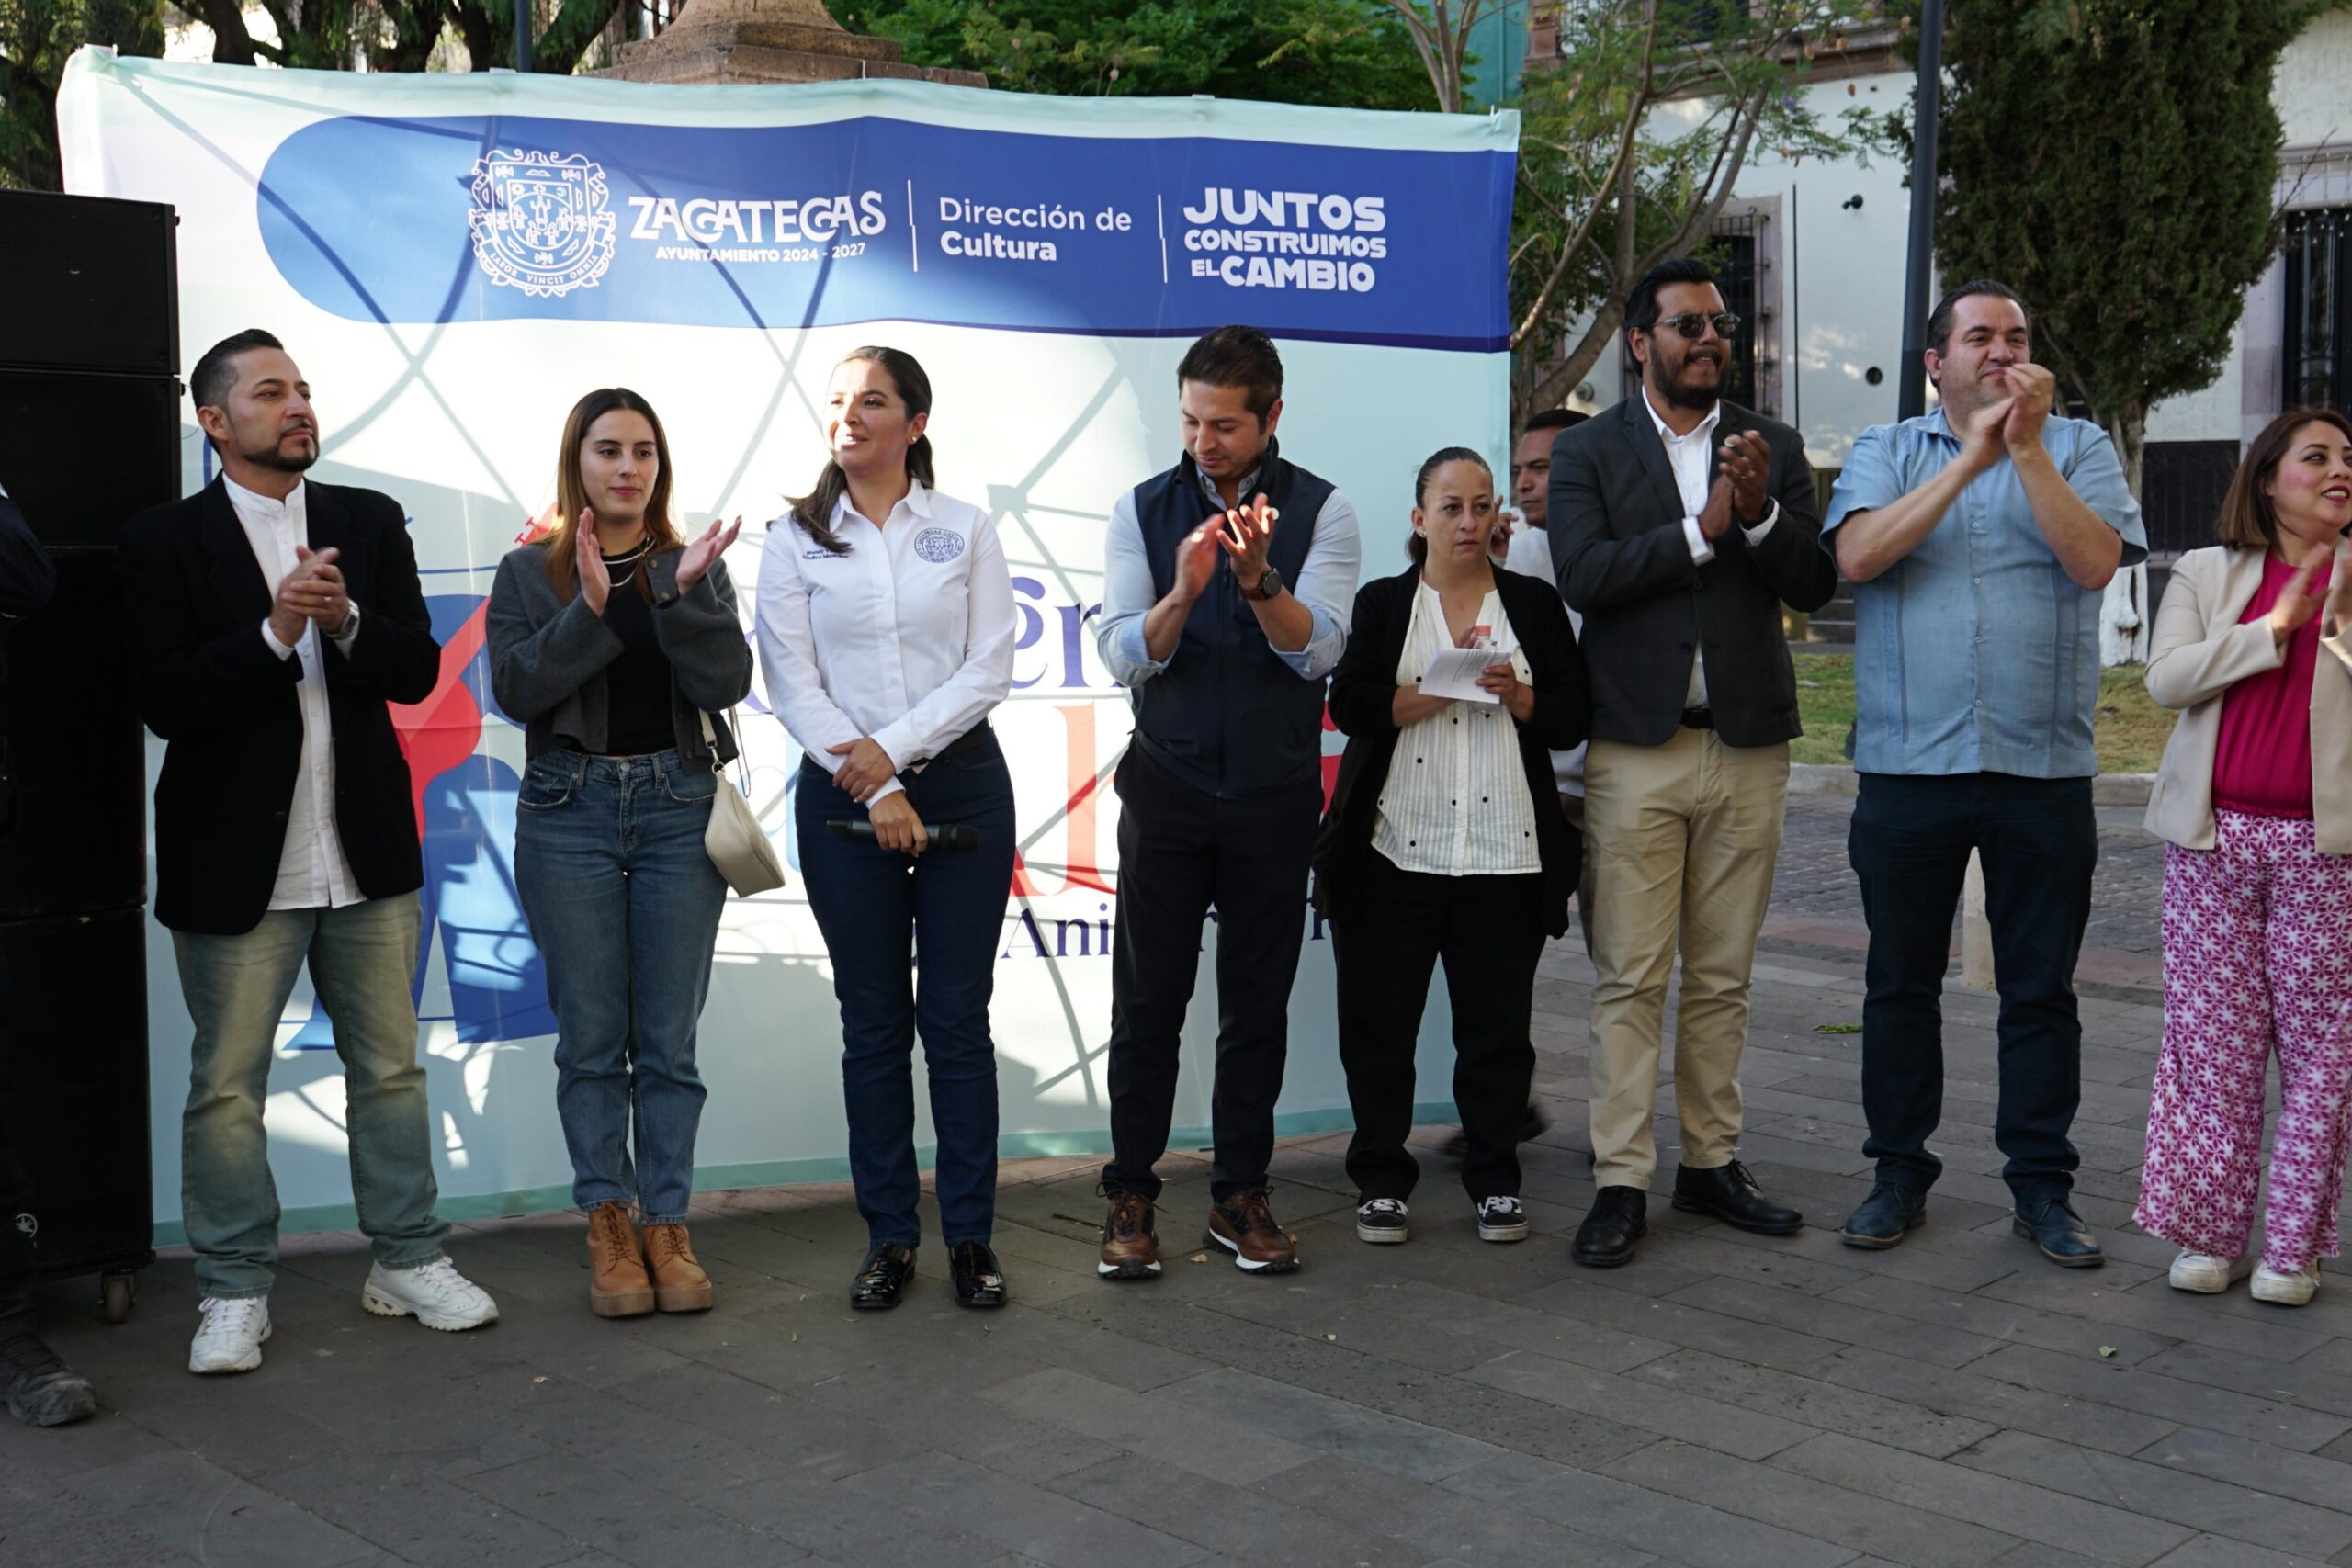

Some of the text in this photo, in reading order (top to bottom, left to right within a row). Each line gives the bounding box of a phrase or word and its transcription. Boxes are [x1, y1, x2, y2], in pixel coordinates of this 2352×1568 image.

[628, 190, 887, 243] ZACATECAS
[940, 197, 1132, 231] Dirección de
[1182, 187, 1386, 232] JUNTOS
[655, 246, 781, 263] AYUNTAMIENTO
[782, 247, 819, 263] 2024
[831, 242, 866, 259] 2027
[940, 231, 1057, 262] Cultura
[1183, 228, 1387, 259] CONSTRUIMOS
[490, 252, 599, 285] LABOR VINCIT OMNIA
[1191, 255, 1376, 293] EL CAMBIO
